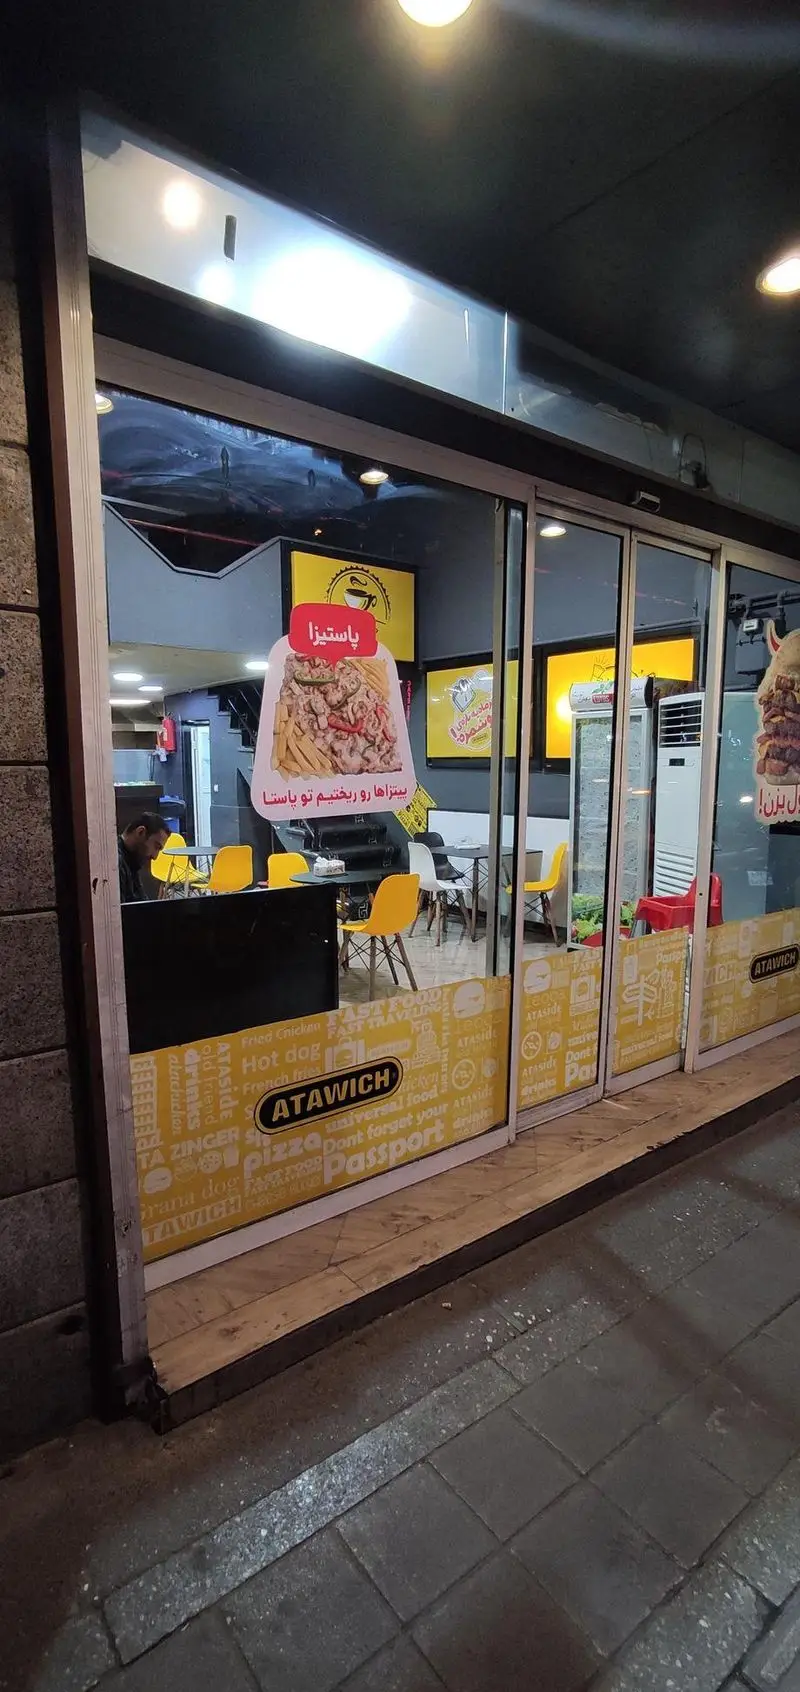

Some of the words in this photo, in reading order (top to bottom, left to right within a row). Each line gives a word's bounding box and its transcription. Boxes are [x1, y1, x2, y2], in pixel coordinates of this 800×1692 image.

[308, 621, 360, 650] پاستیزا
[263, 790, 298, 810] پاستا
[301, 788, 313, 807] تو
[360, 790, 371, 802] رو
[374, 783, 408, 801] پیتزاها
[755, 951, 796, 976] ATAWICH
[328, 1000, 383, 1027] FAST
[387, 989, 442, 1013] FOOD
[242, 1031, 273, 1049] Fried
[276, 1022, 321, 1040] Chicken
[328, 1019, 365, 1040] FAST
[201, 1045, 217, 1072] old
[242, 1050, 279, 1075] Hot
[285, 1042, 321, 1063] dog
[242, 1071, 289, 1096] French
[272, 1068, 390, 1123] ATAWICH
[325, 1096, 404, 1133] universal
[407, 1085, 439, 1107] food
[323, 1130, 364, 1155] Dont
[367, 1112, 413, 1140] forget
[416, 1103, 448, 1125] your
[171, 1126, 239, 1161] ZINGER
[244, 1130, 322, 1178] pizza
[202, 1176, 240, 1200] dog
[145, 1195, 241, 1245] TAWICH
